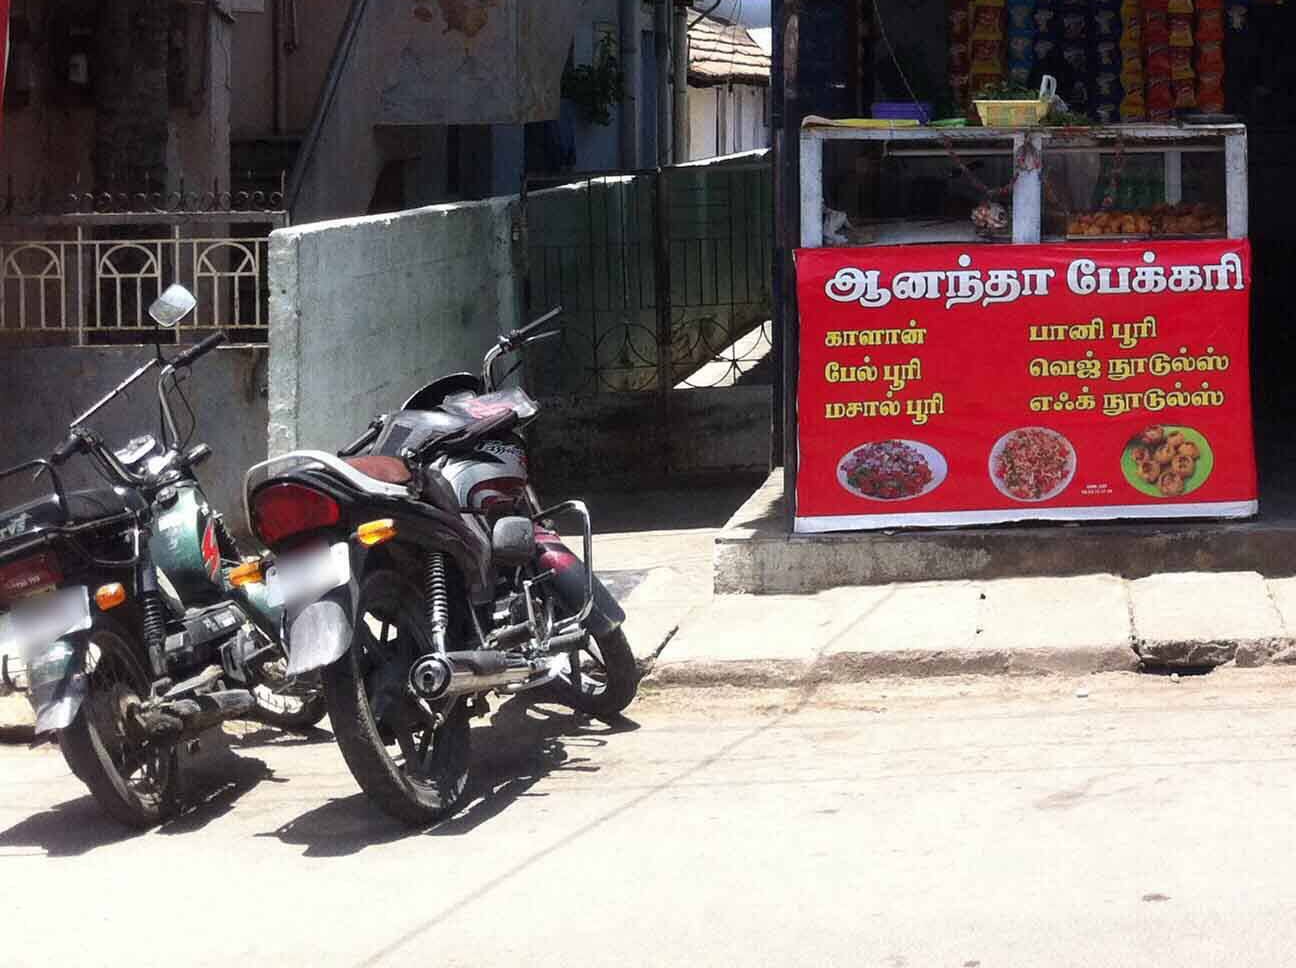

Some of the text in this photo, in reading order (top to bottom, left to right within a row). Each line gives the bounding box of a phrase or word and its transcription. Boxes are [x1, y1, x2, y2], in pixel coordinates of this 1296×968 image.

[824, 250, 1246, 309] ஆனந்தா பேக்கரி
[824, 320, 927, 347] காளான்
[1029, 315, 1158, 350] பானி பூரி
[824, 356, 922, 391] பேல் பூரி
[1029, 346, 1230, 381] வெஜ் நூடுல்ஸ்
[824, 390, 945, 425] மசால் பூரி
[1102, 382, 1225, 416] நூடுல்ஸ்
